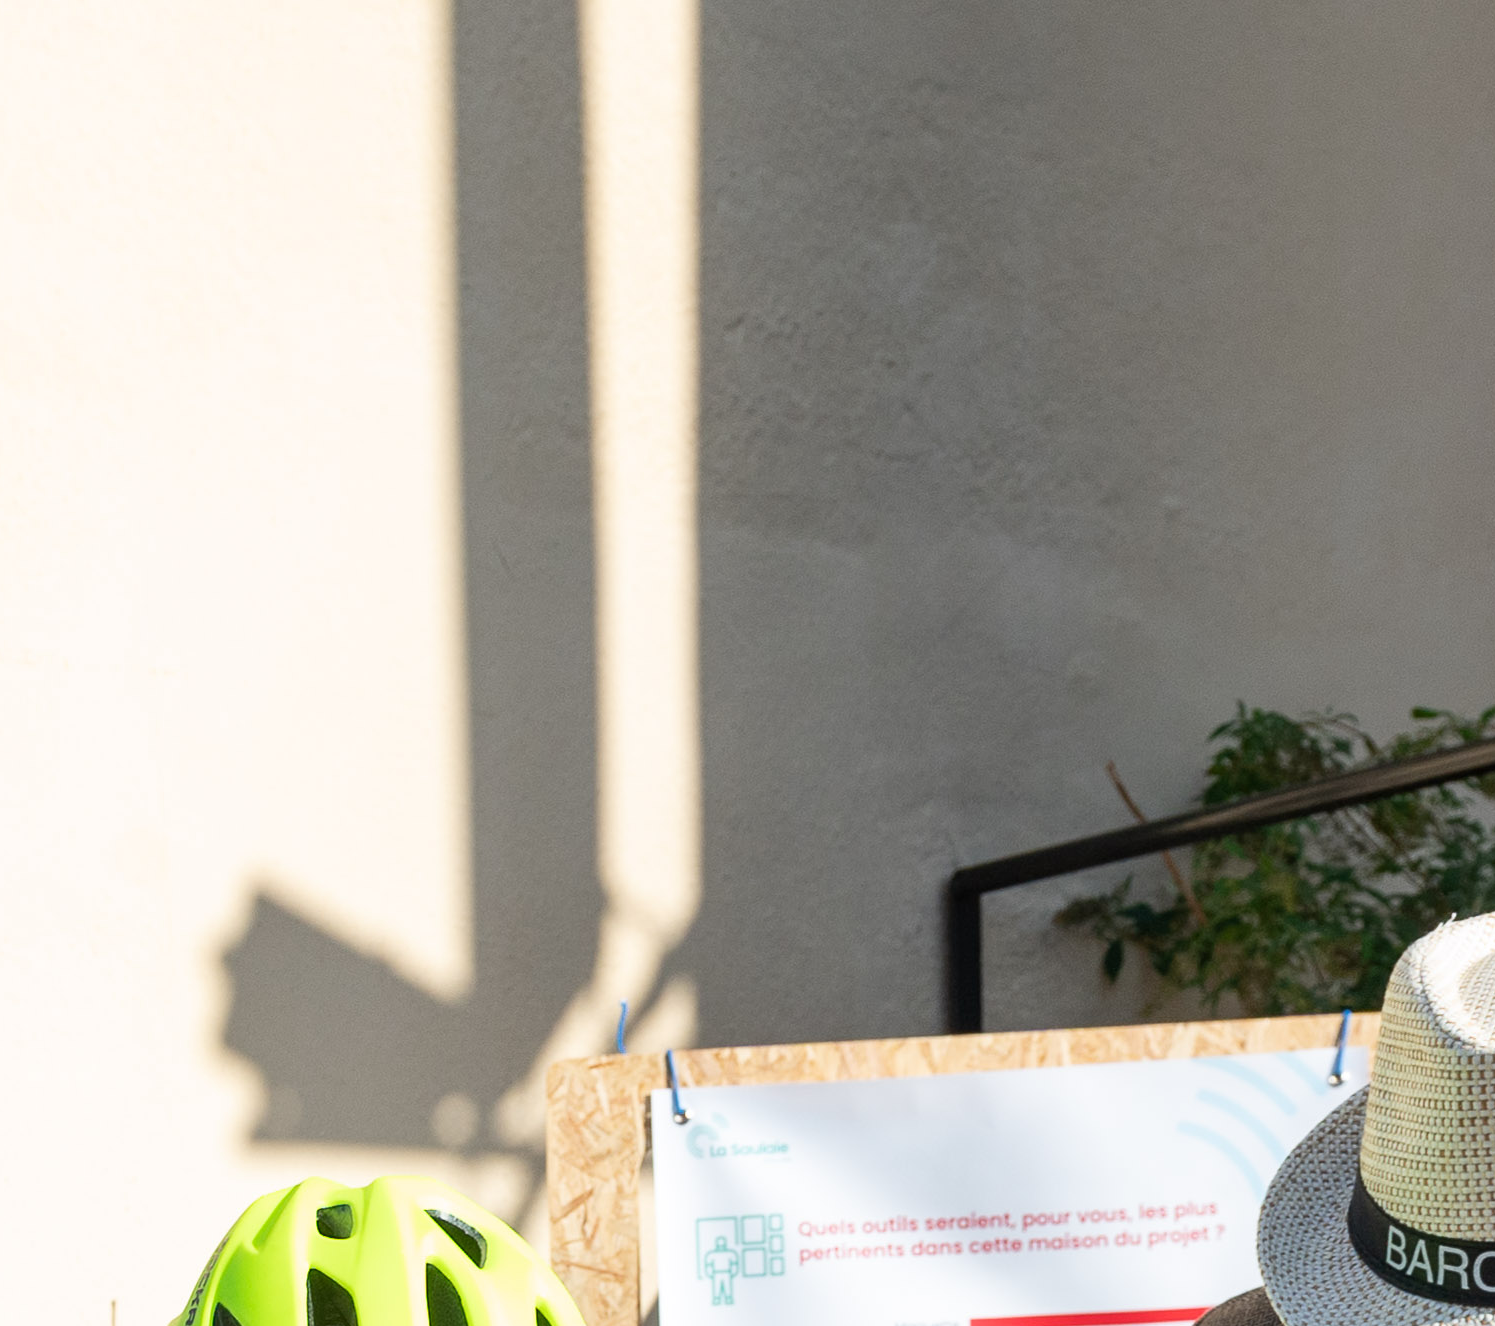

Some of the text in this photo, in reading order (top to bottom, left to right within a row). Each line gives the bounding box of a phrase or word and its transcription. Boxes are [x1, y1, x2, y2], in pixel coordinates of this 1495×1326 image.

[798, 1201, 1218, 1237] Quels outils seraient, pour vous, les plus
[799, 1224, 1226, 1266] pertinents dans cette maison du projet ?
